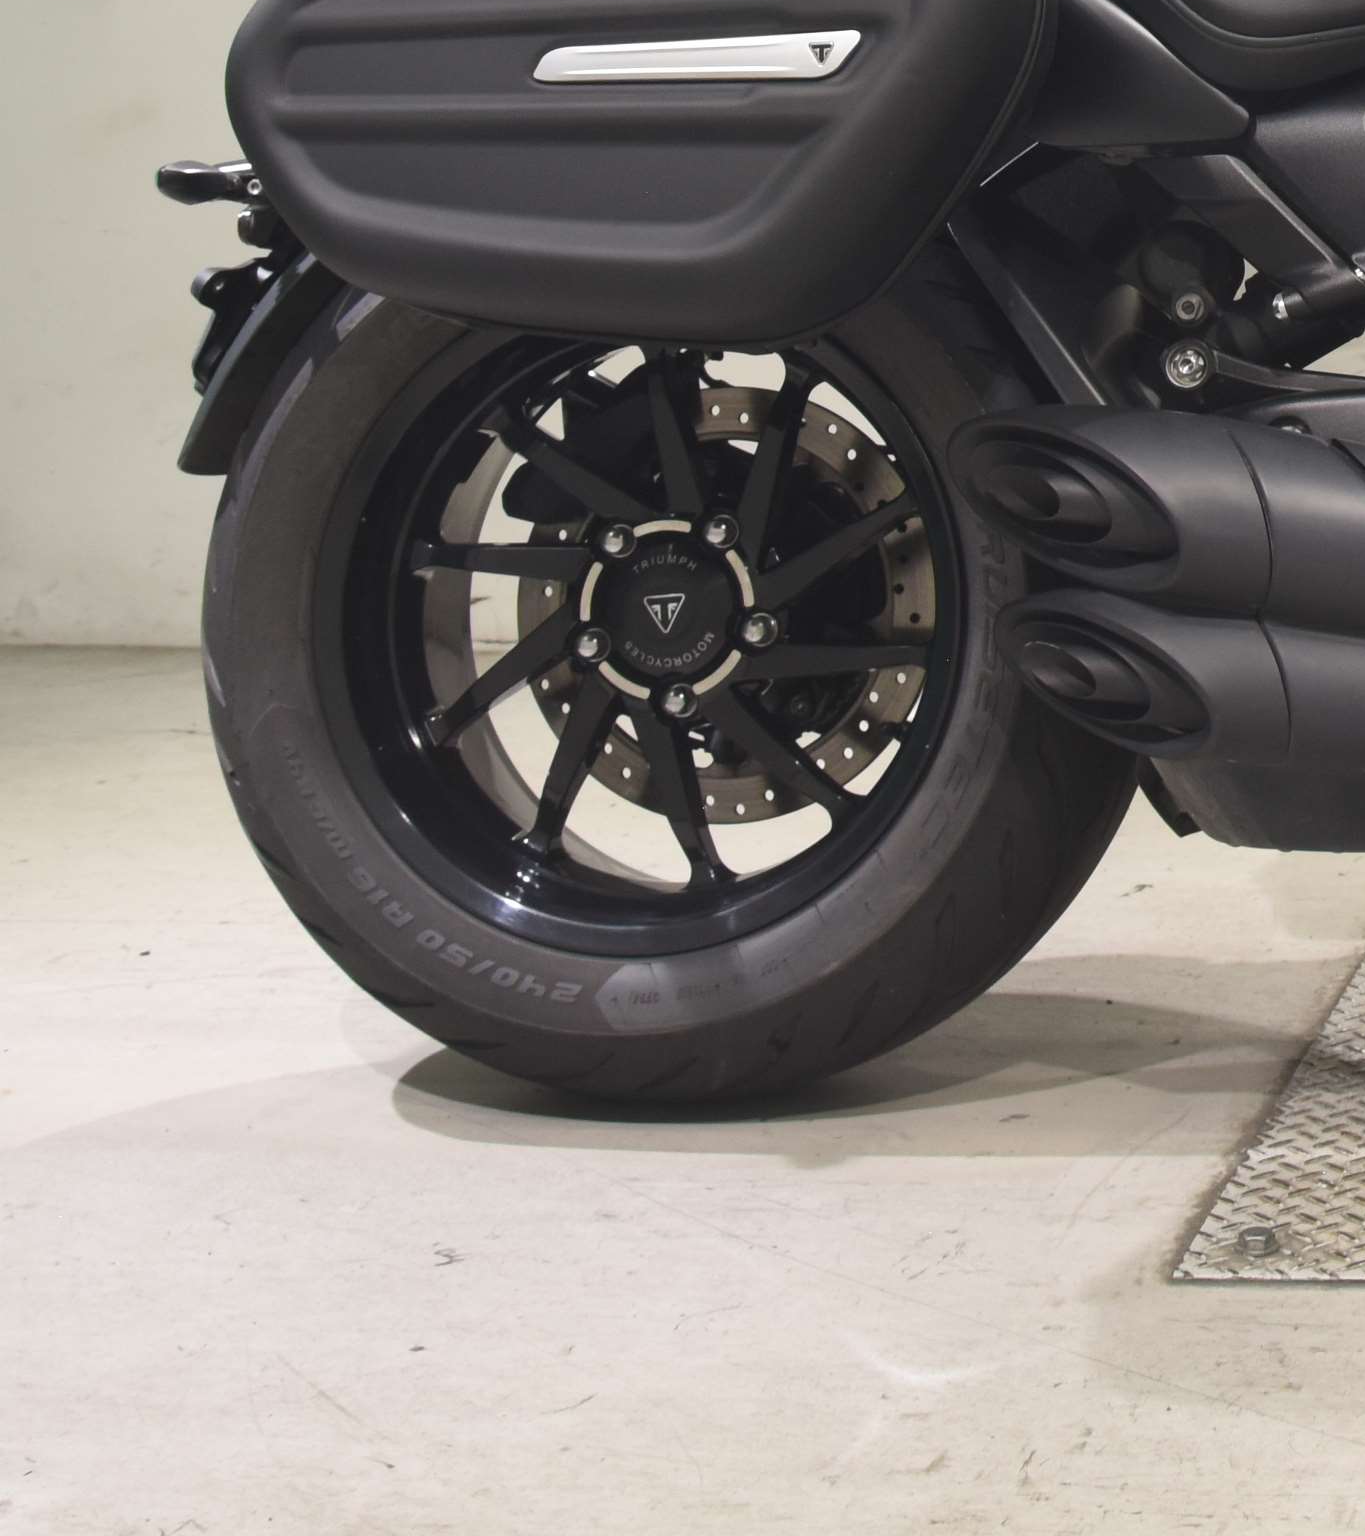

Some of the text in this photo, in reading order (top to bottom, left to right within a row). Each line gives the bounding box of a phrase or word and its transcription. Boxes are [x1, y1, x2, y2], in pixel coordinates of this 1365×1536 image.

[632, 553, 699, 574] TRIUMPH
[624, 631, 716, 668] MOTORCYCLES
[346, 866, 415, 928] R16
[417, 929, 582, 1002] 240/50
